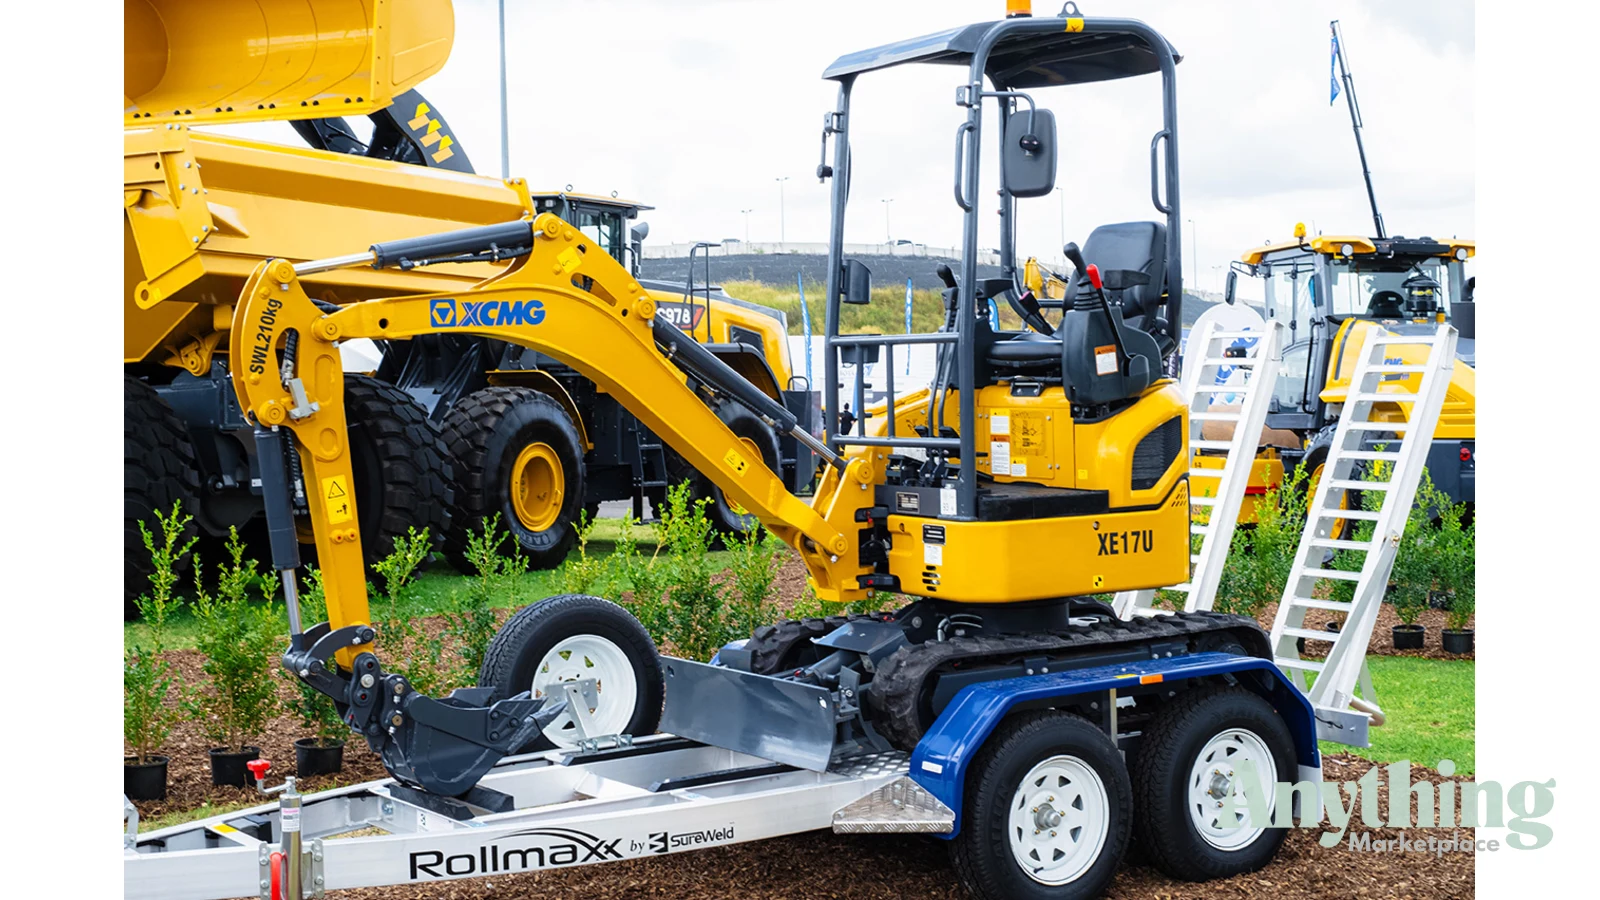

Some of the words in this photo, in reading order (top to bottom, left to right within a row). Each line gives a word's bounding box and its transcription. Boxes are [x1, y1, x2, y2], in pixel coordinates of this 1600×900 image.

[457, 300, 545, 327] XCMG
[248, 298, 283, 375] SWL210kg
[1097, 529, 1153, 556] XE17U
[409, 828, 623, 879] Rollmaxx
[630, 840, 645, 854] by
[670, 827, 734, 848] SureWeld
